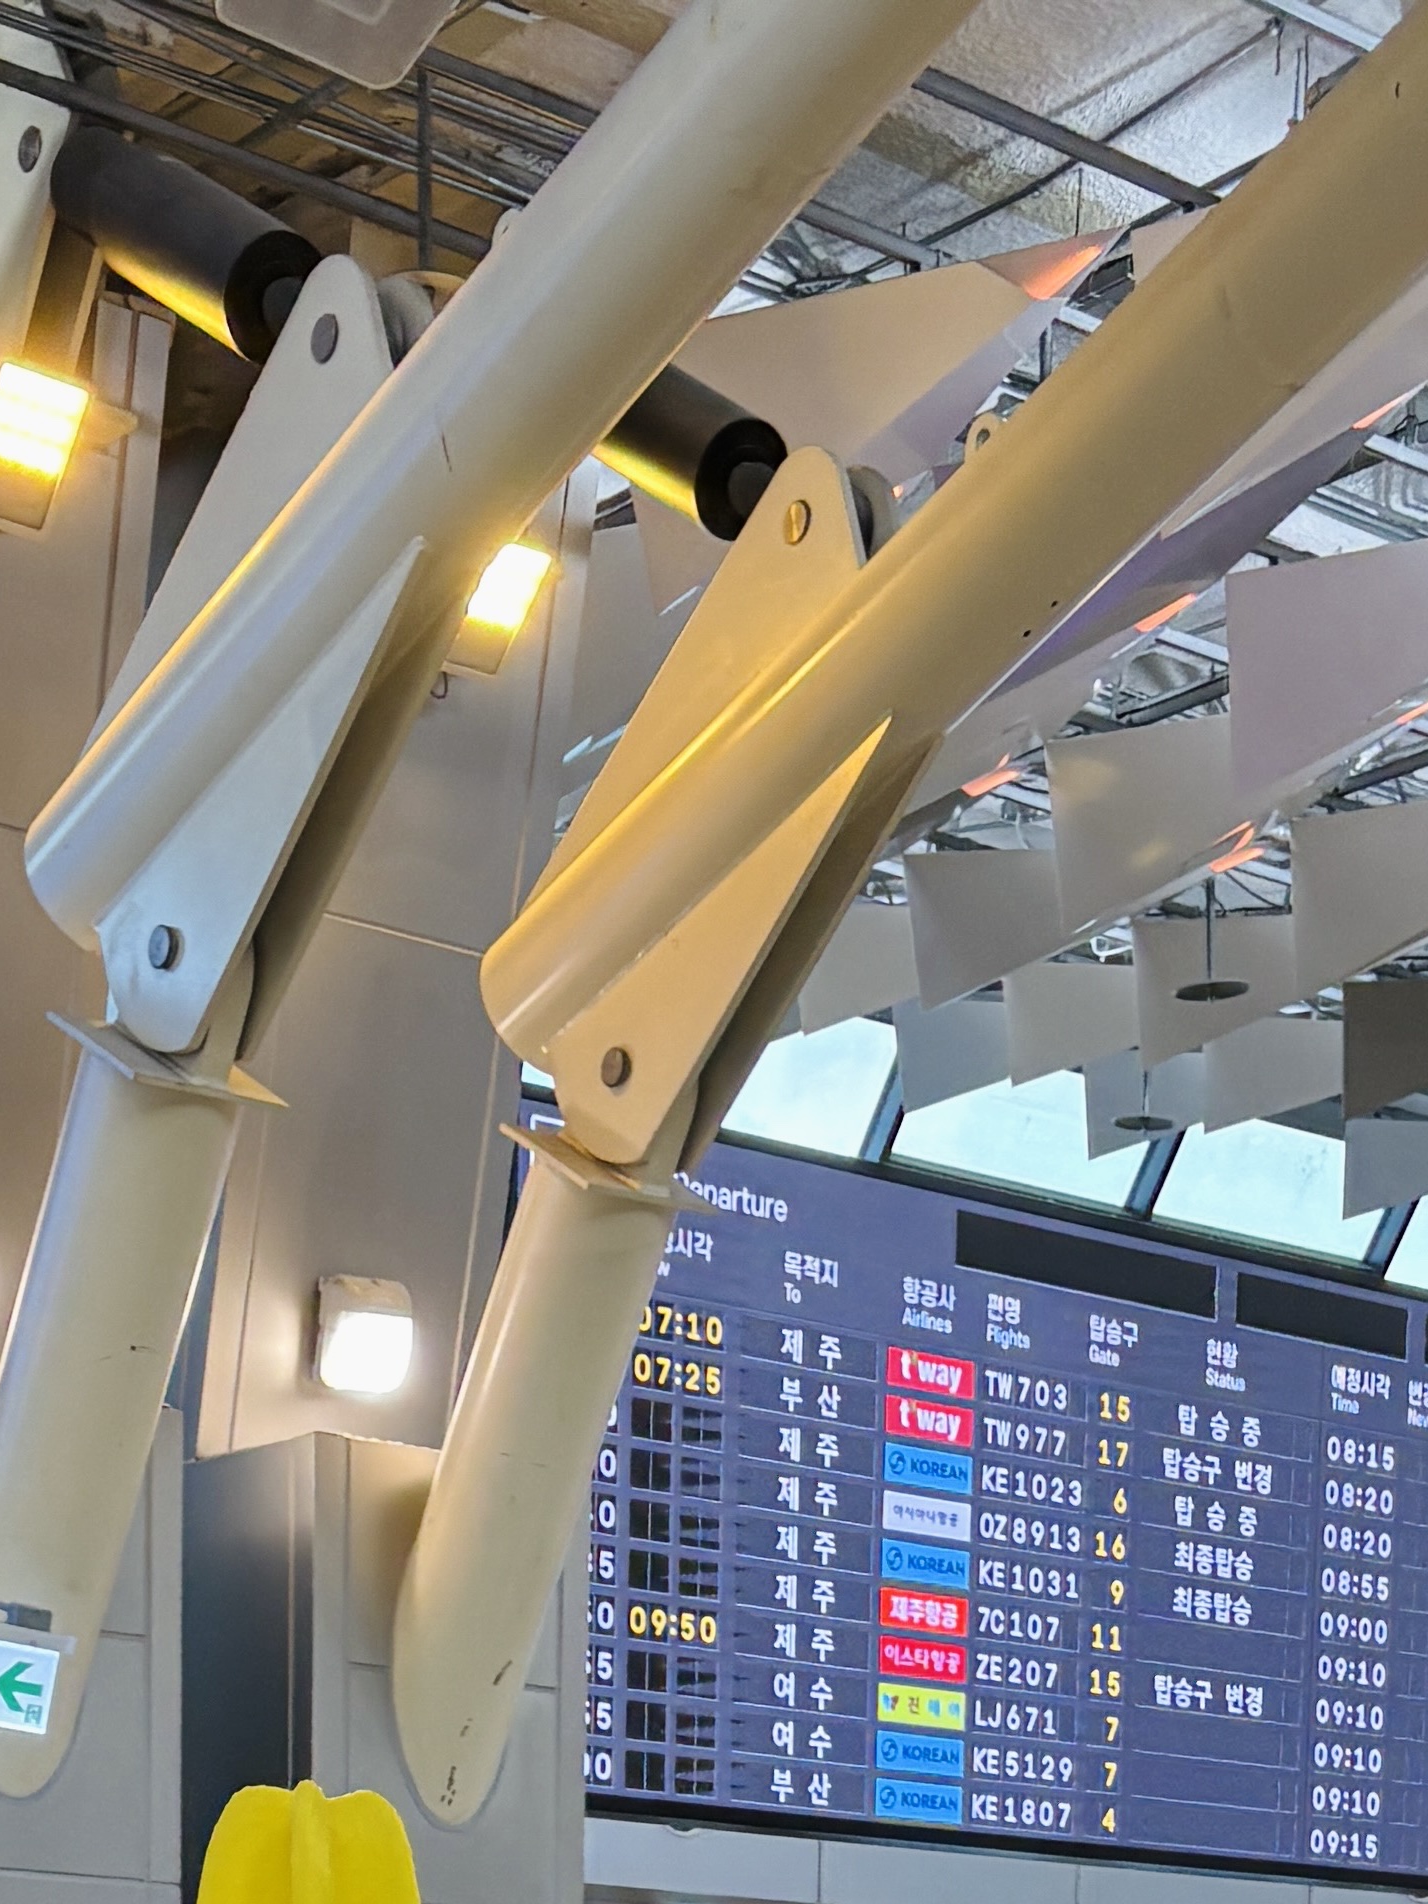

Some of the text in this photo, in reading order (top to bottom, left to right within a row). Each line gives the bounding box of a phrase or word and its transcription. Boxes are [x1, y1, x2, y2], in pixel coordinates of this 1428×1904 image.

[665, 1228, 713, 1262] 시각
[784, 1251, 839, 1287] 목적지
[784, 1283, 801, 1303] To
[903, 1276, 956, 1311] 항공사
[987, 1293, 1021, 1325] 편명
[902, 1308, 952, 1334] Airlines
[1089, 1315, 1139, 1347] 탑승구
[1089, 1344, 1120, 1367] Gate
[1206, 1339, 1239, 1368] 현황
[985, 1369, 1067, 1410] TW703
[1099, 1392, 1130, 1422] 15
[1205, 1367, 1246, 1391] Status
[1331, 1365, 1391, 1400] 예정시각
[1331, 1393, 1360, 1414] Time
[634, 1353, 721, 1395] 07:25
[983, 1417, 1066, 1456] TW977
[1097, 1439, 1129, 1467] 17
[1162, 1447, 1221, 1485] 탑승구
[1234, 1460, 1272, 1494] 변경
[1327, 1436, 1395, 1471] 08:15
[910, 1456, 967, 1481] KOREAN
[981, 1464, 1082, 1507] KE1023
[1113, 1488, 1127, 1514] 6
[1325, 1480, 1394, 1515] 08:20
[979, 1512, 1081, 1552] OZ8913
[1095, 1531, 1126, 1560] 16
[1174, 1542, 1254, 1582] 최종탑승
[1323, 1524, 1392, 1559] 08:20
[907, 1554, 965, 1576] KOREAN
[978, 1559, 1078, 1599] KE1031
[1110, 1579, 1124, 1606] 9
[1172, 1586, 1252, 1626] 최종탑승
[1321, 1568, 1390, 1602] 08:55
[889, 1595, 958, 1629] 제주항공
[978, 1606, 1060, 1641] 7C107
[1091, 1624, 1121, 1651] 11
[1320, 1611, 1388, 1645] 09:00
[629, 1606, 717, 1644] 09:50
[884, 1645, 961, 1672] 이스타항공
[976, 1654, 1058, 1688] ZE207
[1090, 1669, 1120, 1697] 15
[1154, 1675, 1213, 1709] 탑승구
[1225, 1684, 1263, 1717] 변경
[1318, 1655, 1386, 1688] 09:10
[975, 1700, 1056, 1735] LJ671
[1105, 1717, 1119, 1741] 7
[1316, 1699, 1384, 1731] 09:10
[902, 1746, 960, 1766] KOREAN
[973, 1747, 1072, 1782] KE5129
[1103, 1762, 1117, 1787] 7
[1314, 1742, 1382, 1774] 09:10
[901, 1793, 959, 1813] KOREAN
[971, 1793, 1071, 1829] KE1807
[1102, 1808, 1116, 1833] 4
[1312, 1785, 1380, 1817] 09:10
[1310, 1829, 1378, 1860] 09:15
